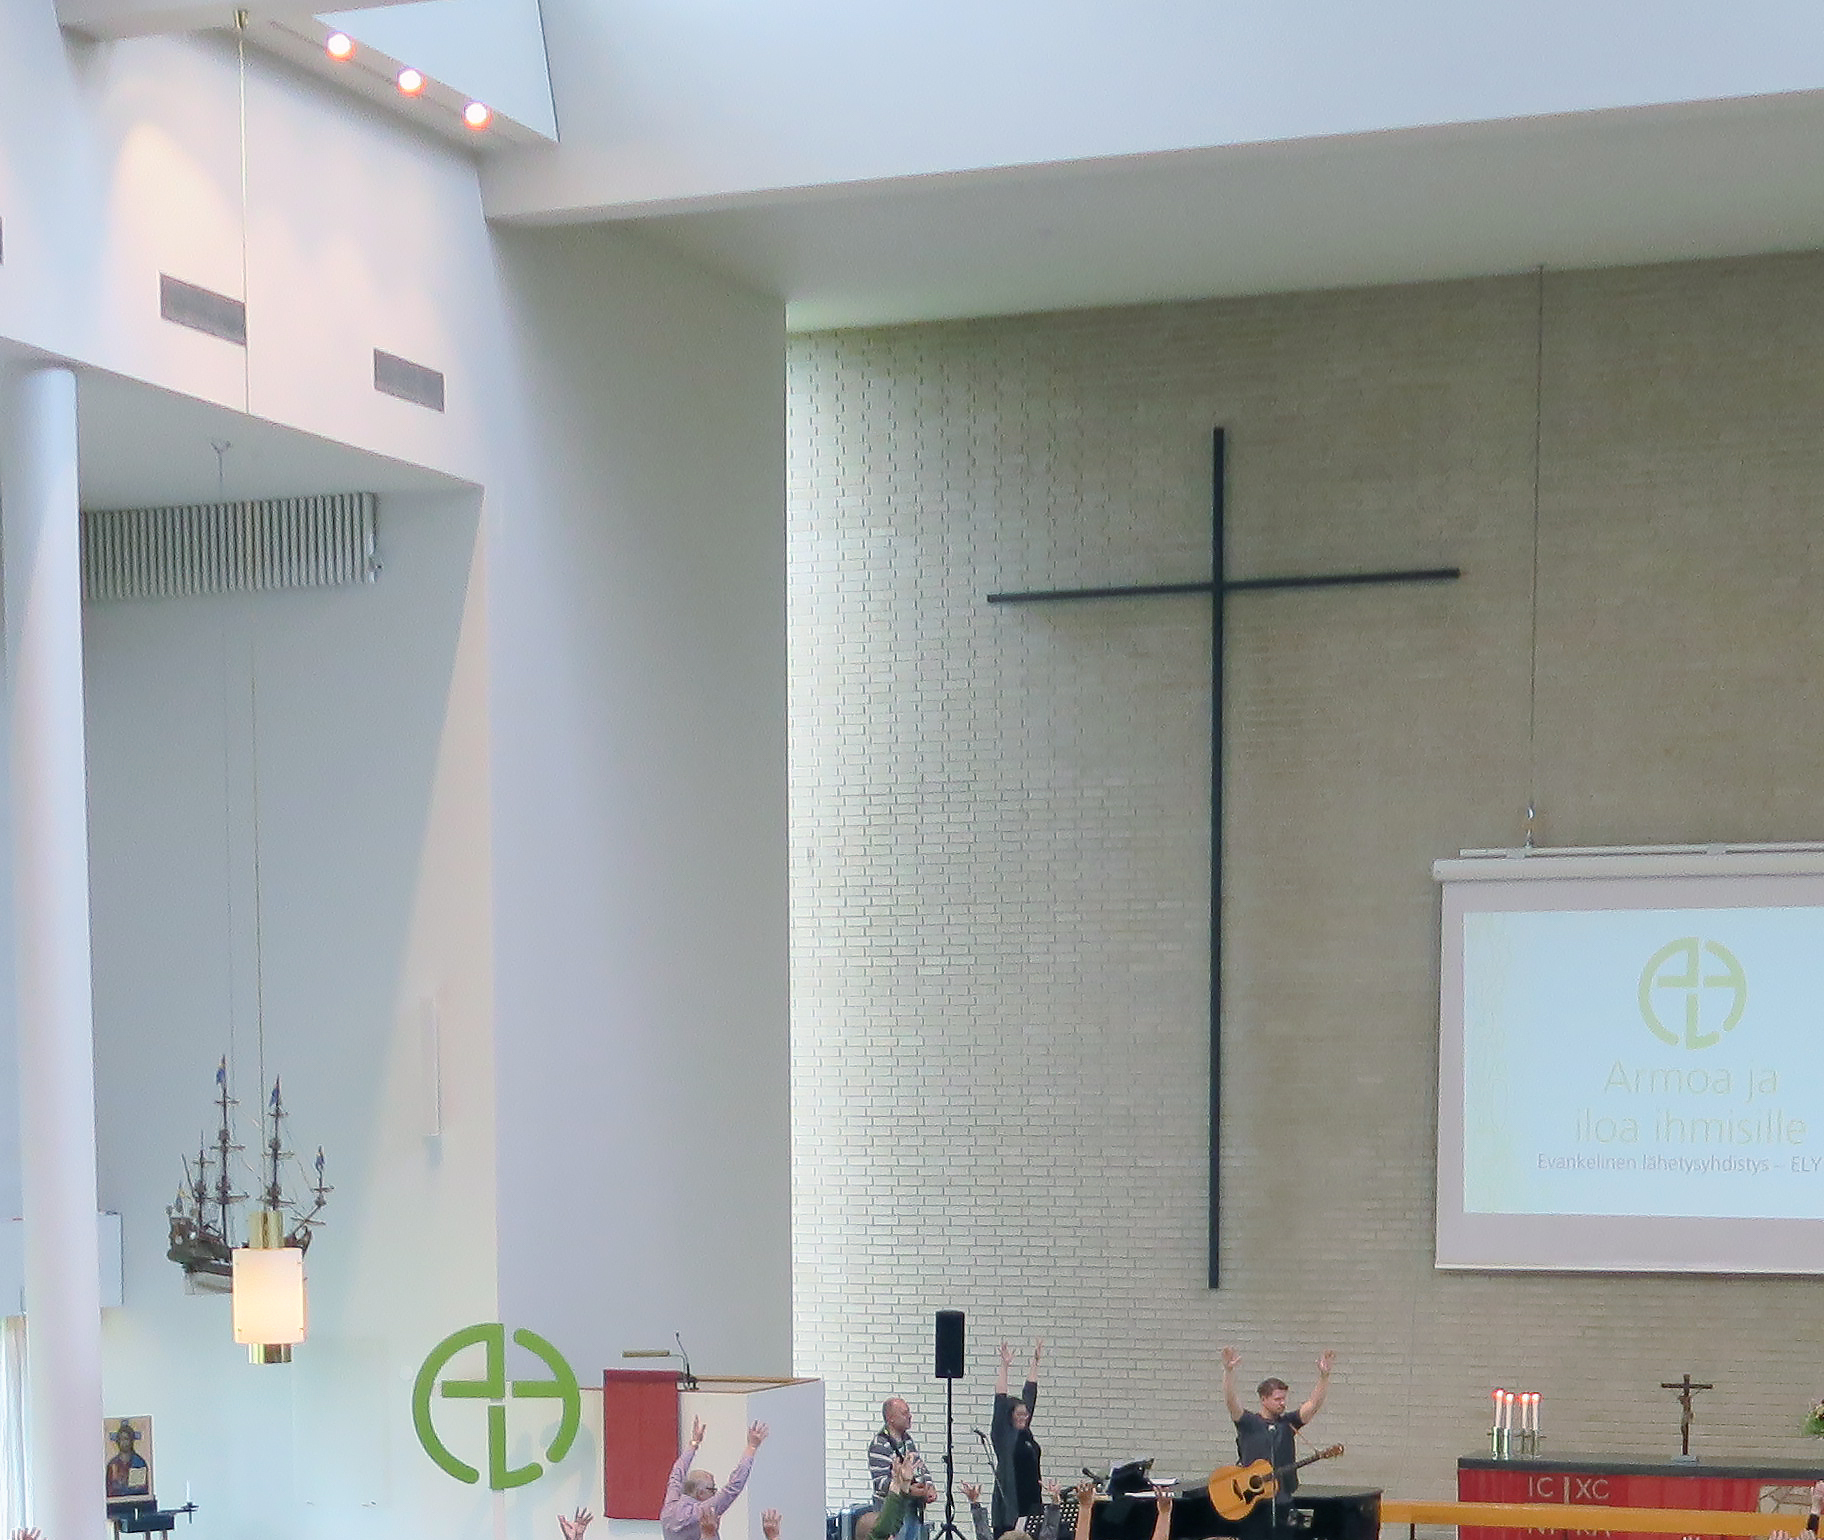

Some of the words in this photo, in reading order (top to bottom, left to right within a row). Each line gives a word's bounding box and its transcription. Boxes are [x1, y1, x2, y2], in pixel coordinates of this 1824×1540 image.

[1604, 1059, 1733, 1096] Armoa
[1744, 1059, 1781, 1104] ja
[1575, 1107, 1640, 1145] iloa
[1654, 1107, 1809, 1146] ihmisille
[1537, 1153, 1637, 1171] Evankelinen
[1642, 1153, 1770, 1176] lähetysyhdistys
[1791, 1155, 1822, 1173] ELY
